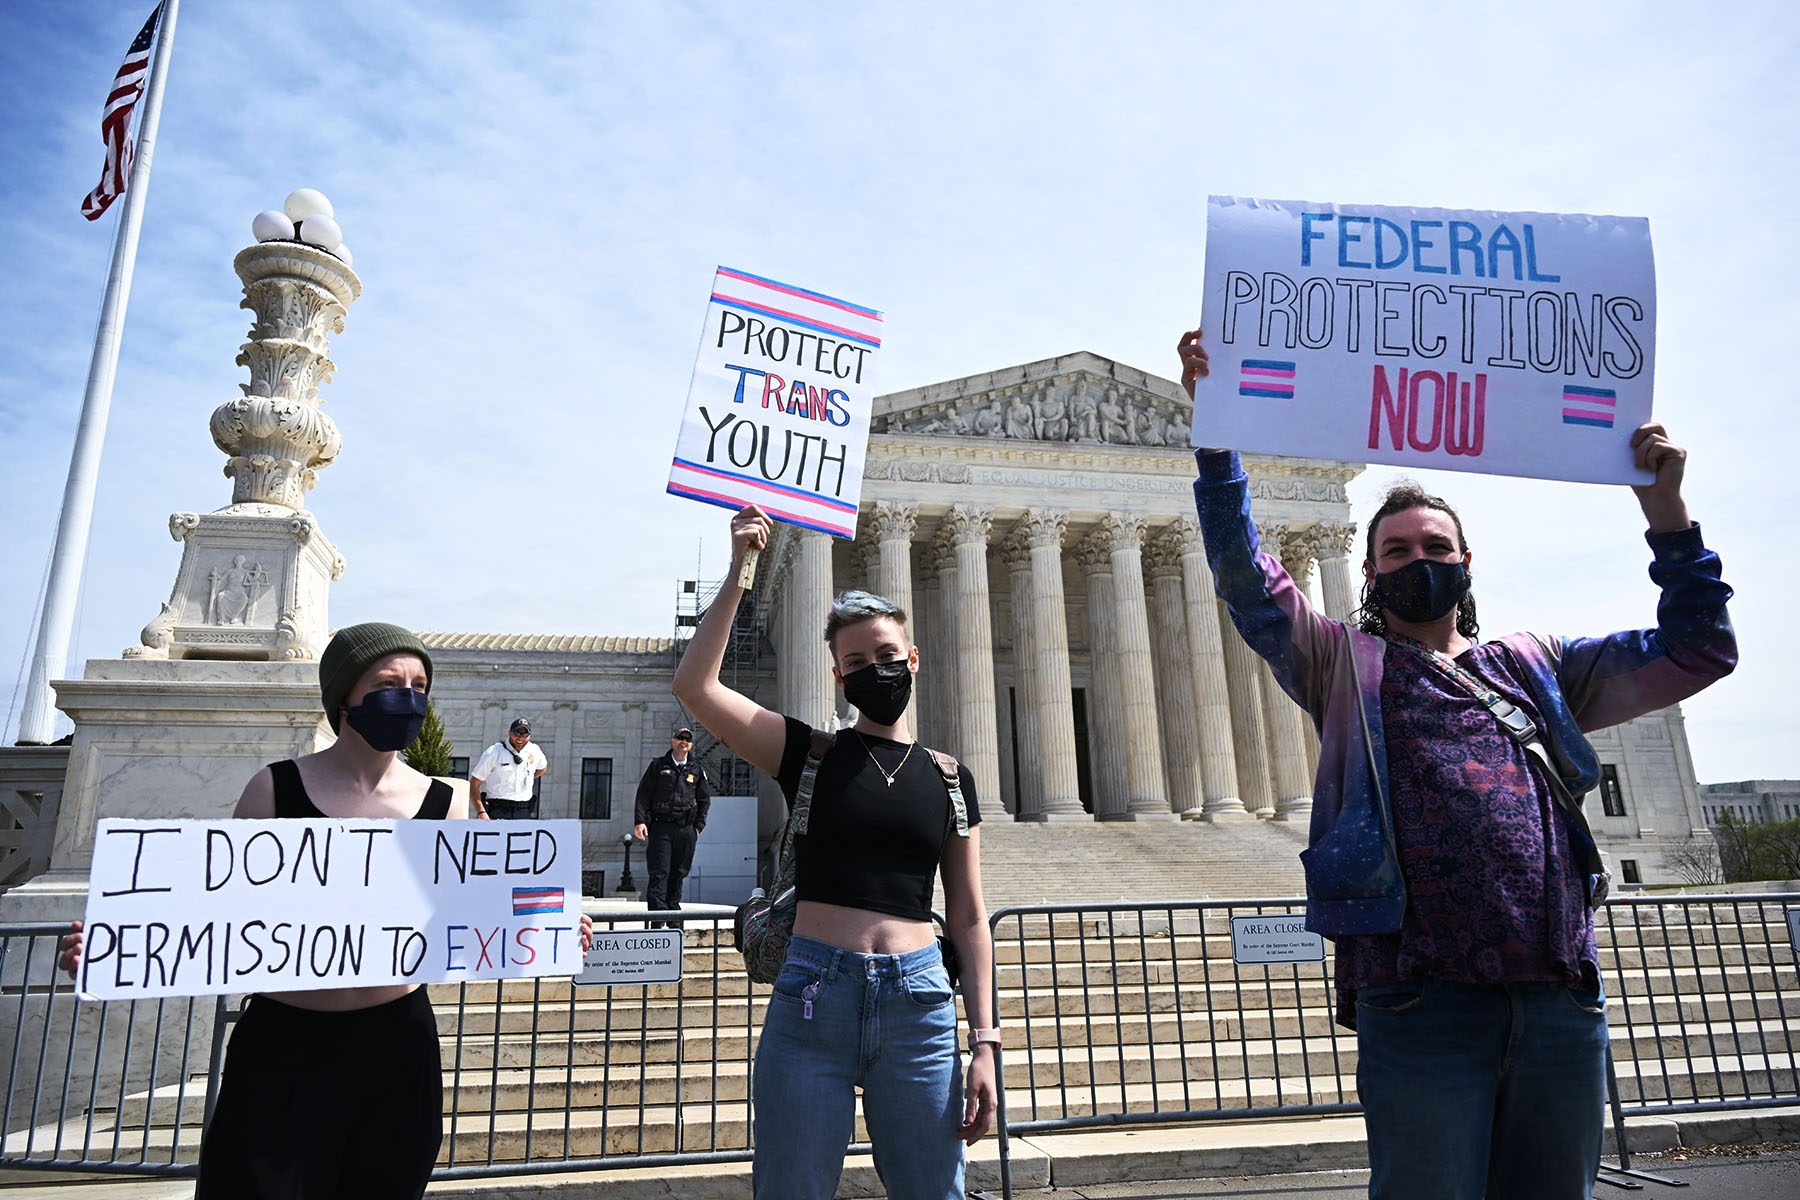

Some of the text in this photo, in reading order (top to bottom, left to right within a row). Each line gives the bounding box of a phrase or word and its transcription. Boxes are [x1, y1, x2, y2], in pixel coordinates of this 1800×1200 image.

[1301, 213, 1560, 282] FEDERAL
[717, 310, 872, 384] PROTECT
[1223, 271, 1643, 379] PROTECTIONS
[725, 363, 850, 427] TRANS
[1368, 365, 1487, 456] NOW
[699, 406, 846, 497] YOUTH
[982, 470, 1187, 492] EQUAL JUSTICE UNDER LAW
[102, 826, 557, 897] I DON'T NEED
[81, 919, 573, 993] PERMISSION TO EXIST
[587, 938, 671, 951] AREA CLOSED
[1243, 923, 1305, 935] AREA CLOSE
